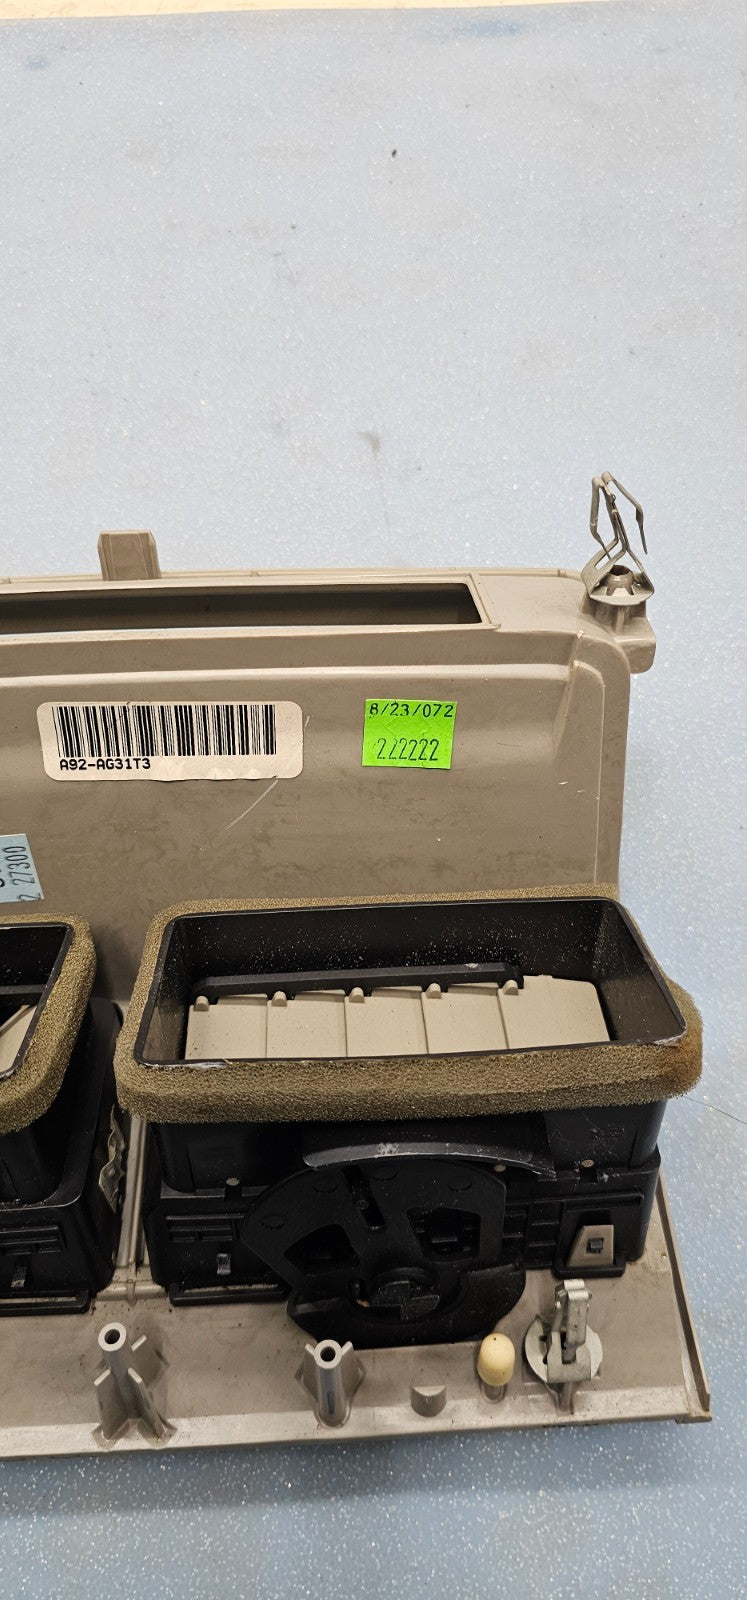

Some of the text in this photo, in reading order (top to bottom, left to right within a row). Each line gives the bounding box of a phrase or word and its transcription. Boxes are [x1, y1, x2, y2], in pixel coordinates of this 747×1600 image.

[369, 702, 454, 718] 8/23/072
[376, 738, 440, 762] 222222
[59, 758, 152, 771] A92-AG31T3
[3, 846, 36, 886] 27300
